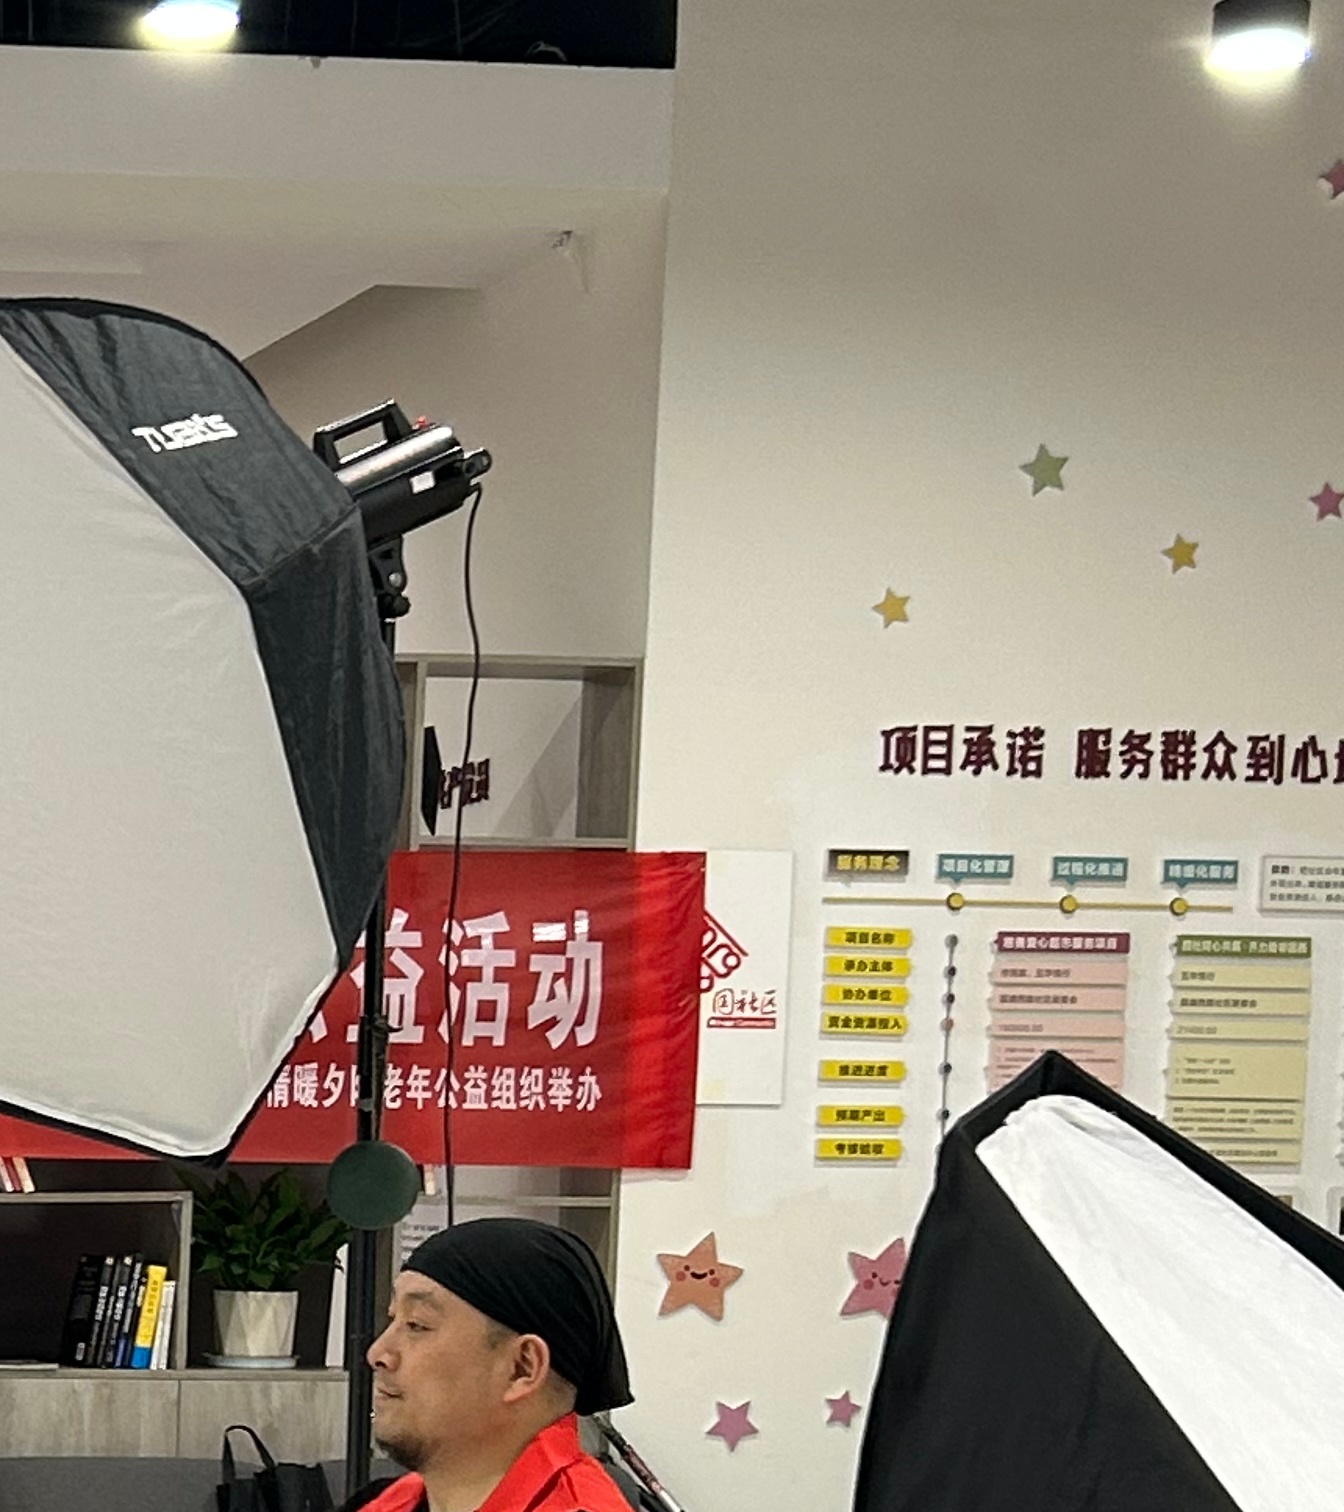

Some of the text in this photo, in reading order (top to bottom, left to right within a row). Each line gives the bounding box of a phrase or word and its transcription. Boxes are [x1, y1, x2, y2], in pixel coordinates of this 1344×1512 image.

[879, 725, 1045, 779] 项目承诺
[308, 907, 603, 1050] 益活动
